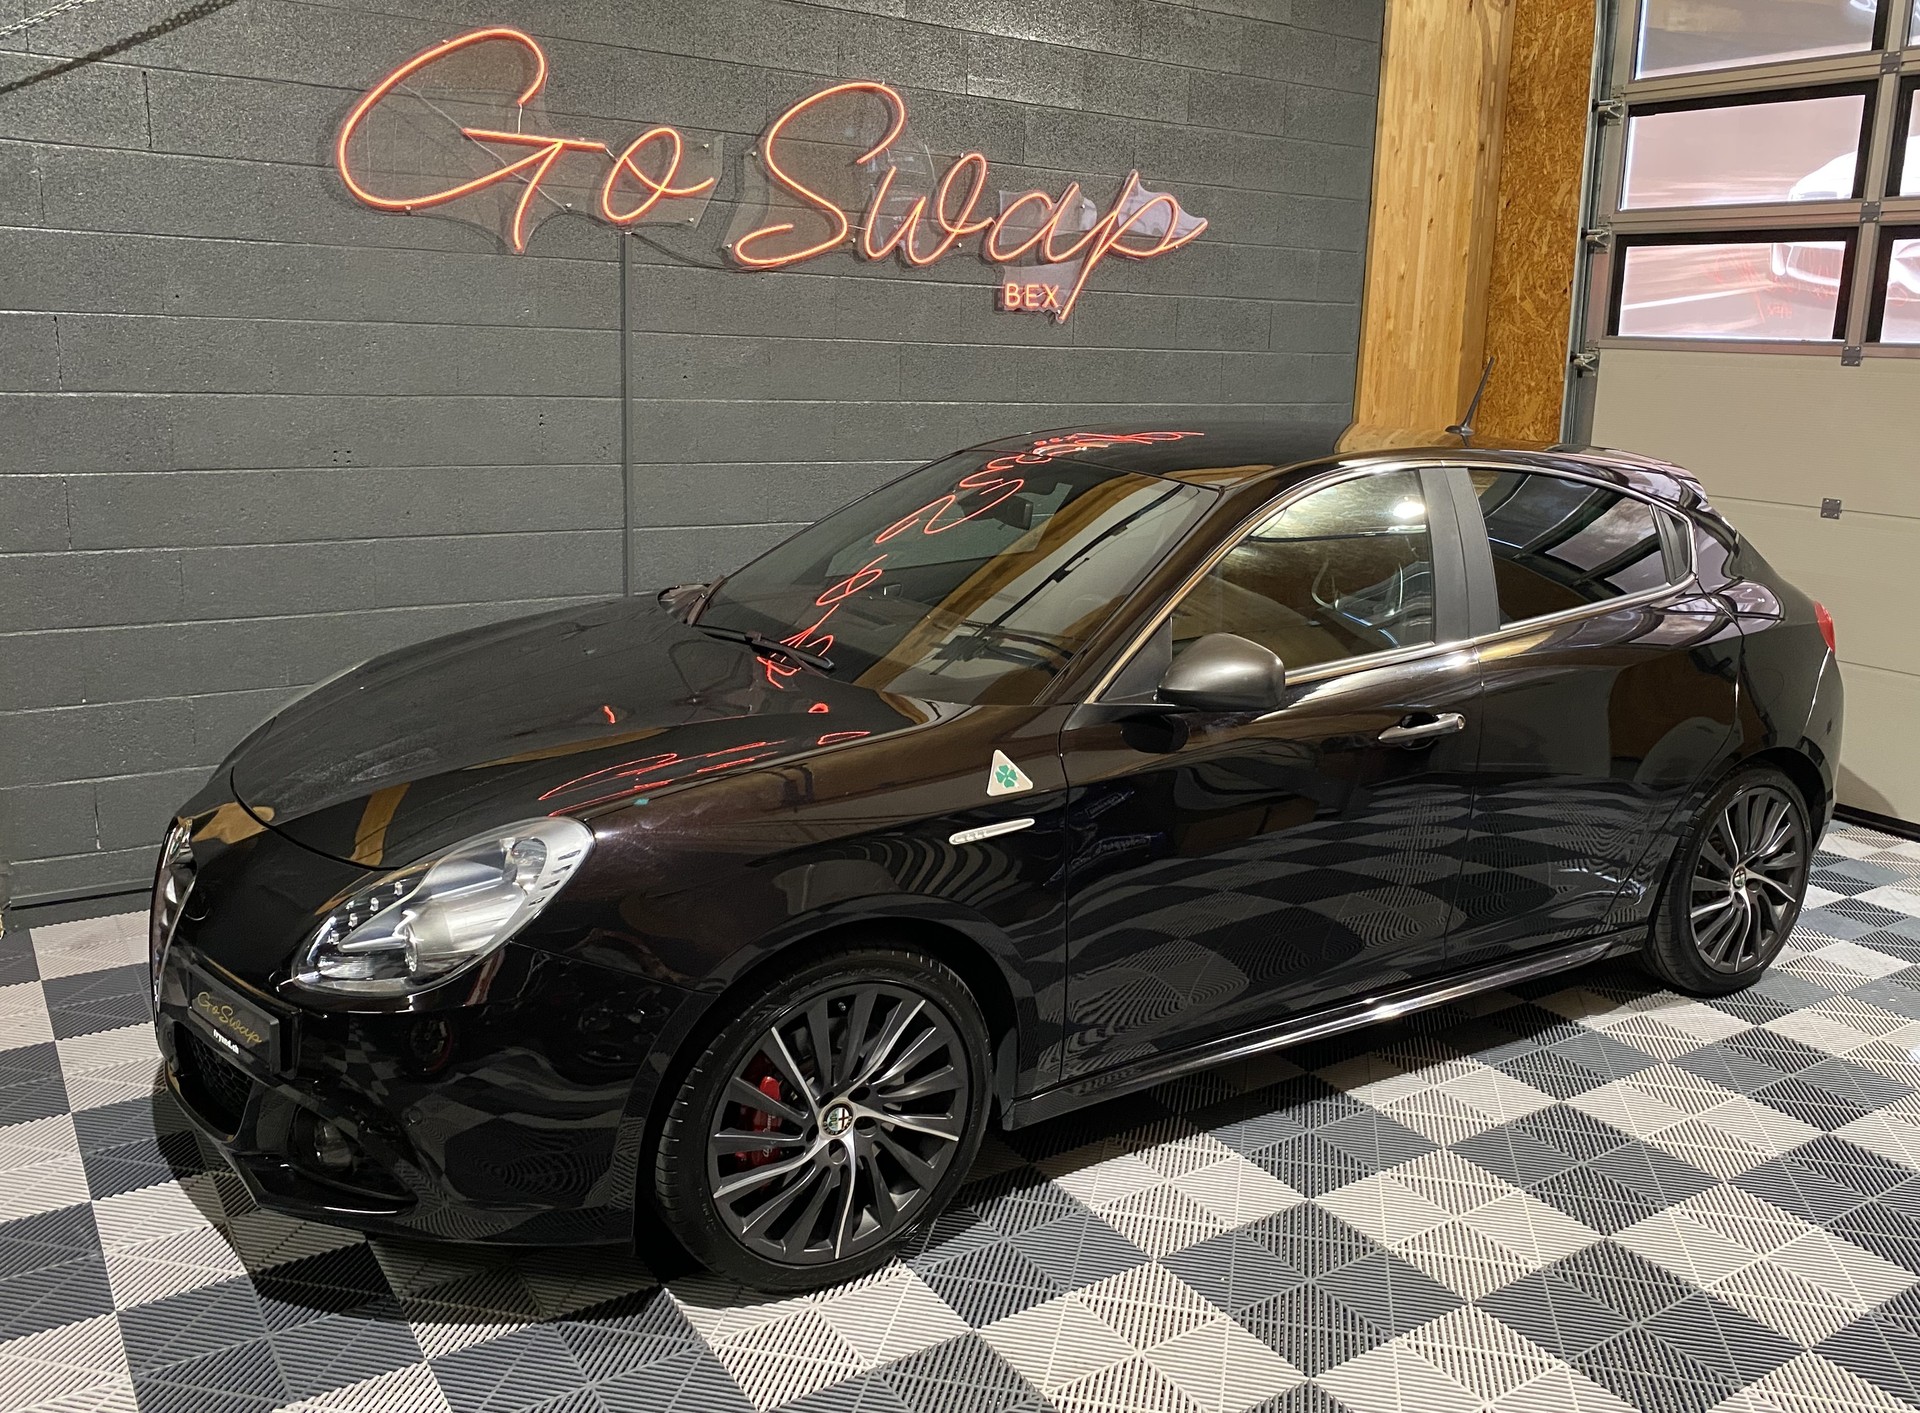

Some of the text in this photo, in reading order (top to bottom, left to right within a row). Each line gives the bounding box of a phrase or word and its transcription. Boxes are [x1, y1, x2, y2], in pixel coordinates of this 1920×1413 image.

[336, 26, 1209, 323] Go Swap
[1004, 282, 1060, 309] BEX
